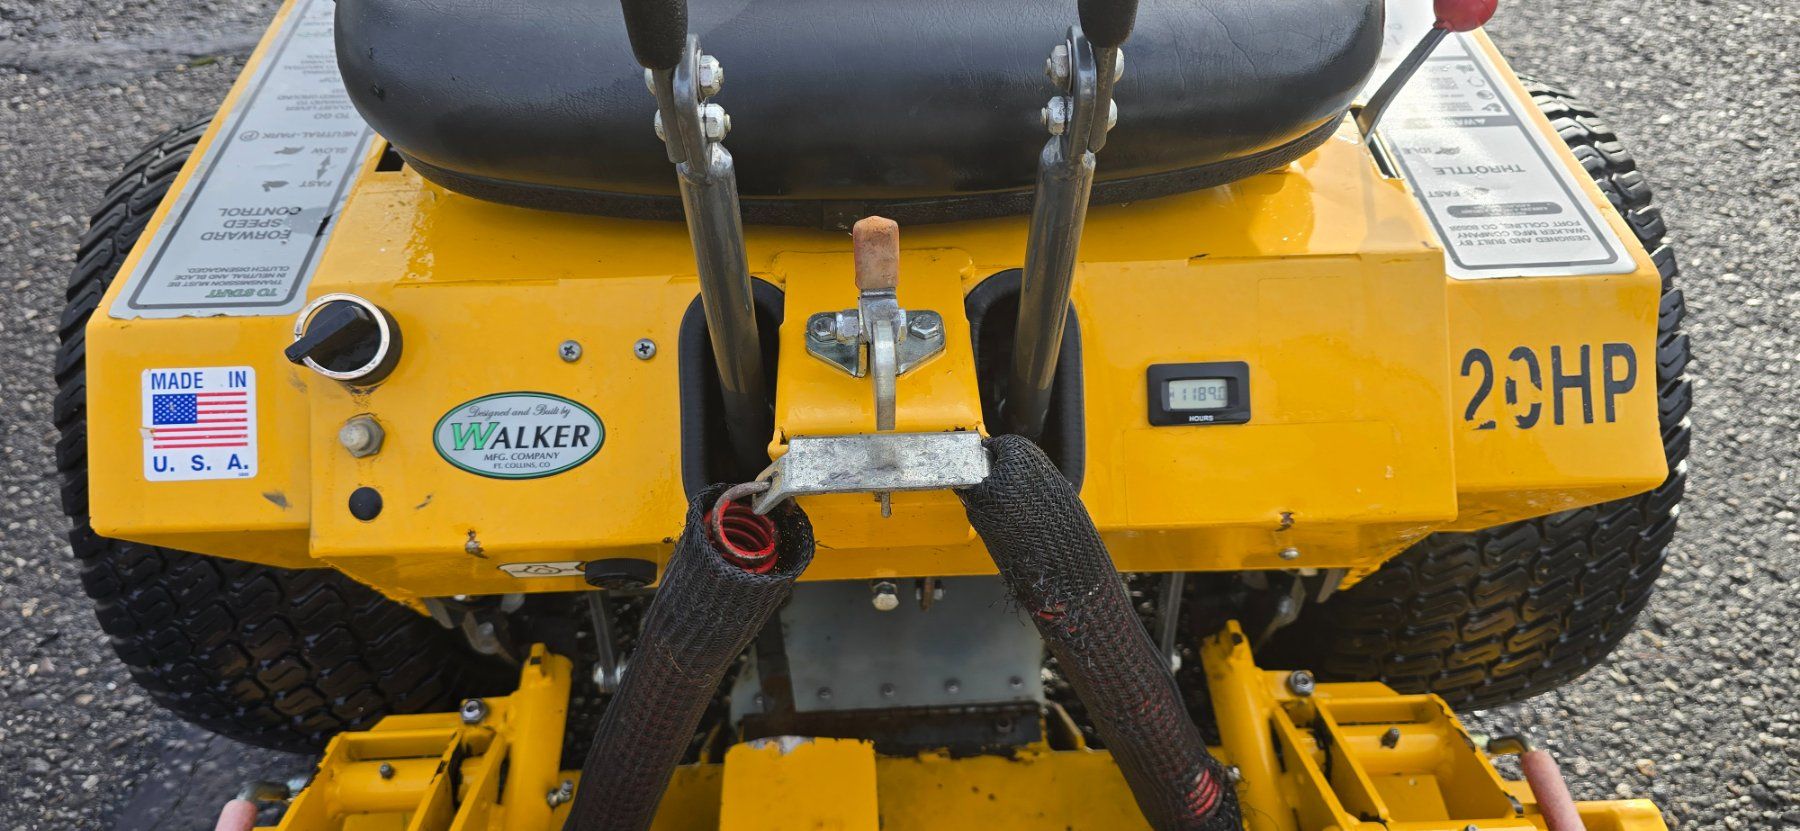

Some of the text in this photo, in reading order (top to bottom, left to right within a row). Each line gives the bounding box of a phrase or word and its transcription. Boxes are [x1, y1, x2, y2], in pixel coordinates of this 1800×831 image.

[1432, 164, 1526, 176] THROTTLE
[1427, 190, 1460, 198] FAST
[218, 207, 302, 217] CONTROL
[222, 218, 283, 228] SPEED
[200, 230, 292, 241] FORWARD
[1457, 230, 1510, 239] COMPANY
[1541, 227, 1586, 235] WALKER
[1535, 234, 1591, 243] DESIGNED
[212, 279, 283, 287] TRANSMISSION
[205, 288, 278, 298] TO START
[151, 370, 246, 390] MADE IN
[1460, 342, 1637, 430] 20HP
[467, 404, 571, 420] Designed and Built by
[450, 421, 591, 451] WALKER
[483, 451, 560, 461] MFG. COMPANY
